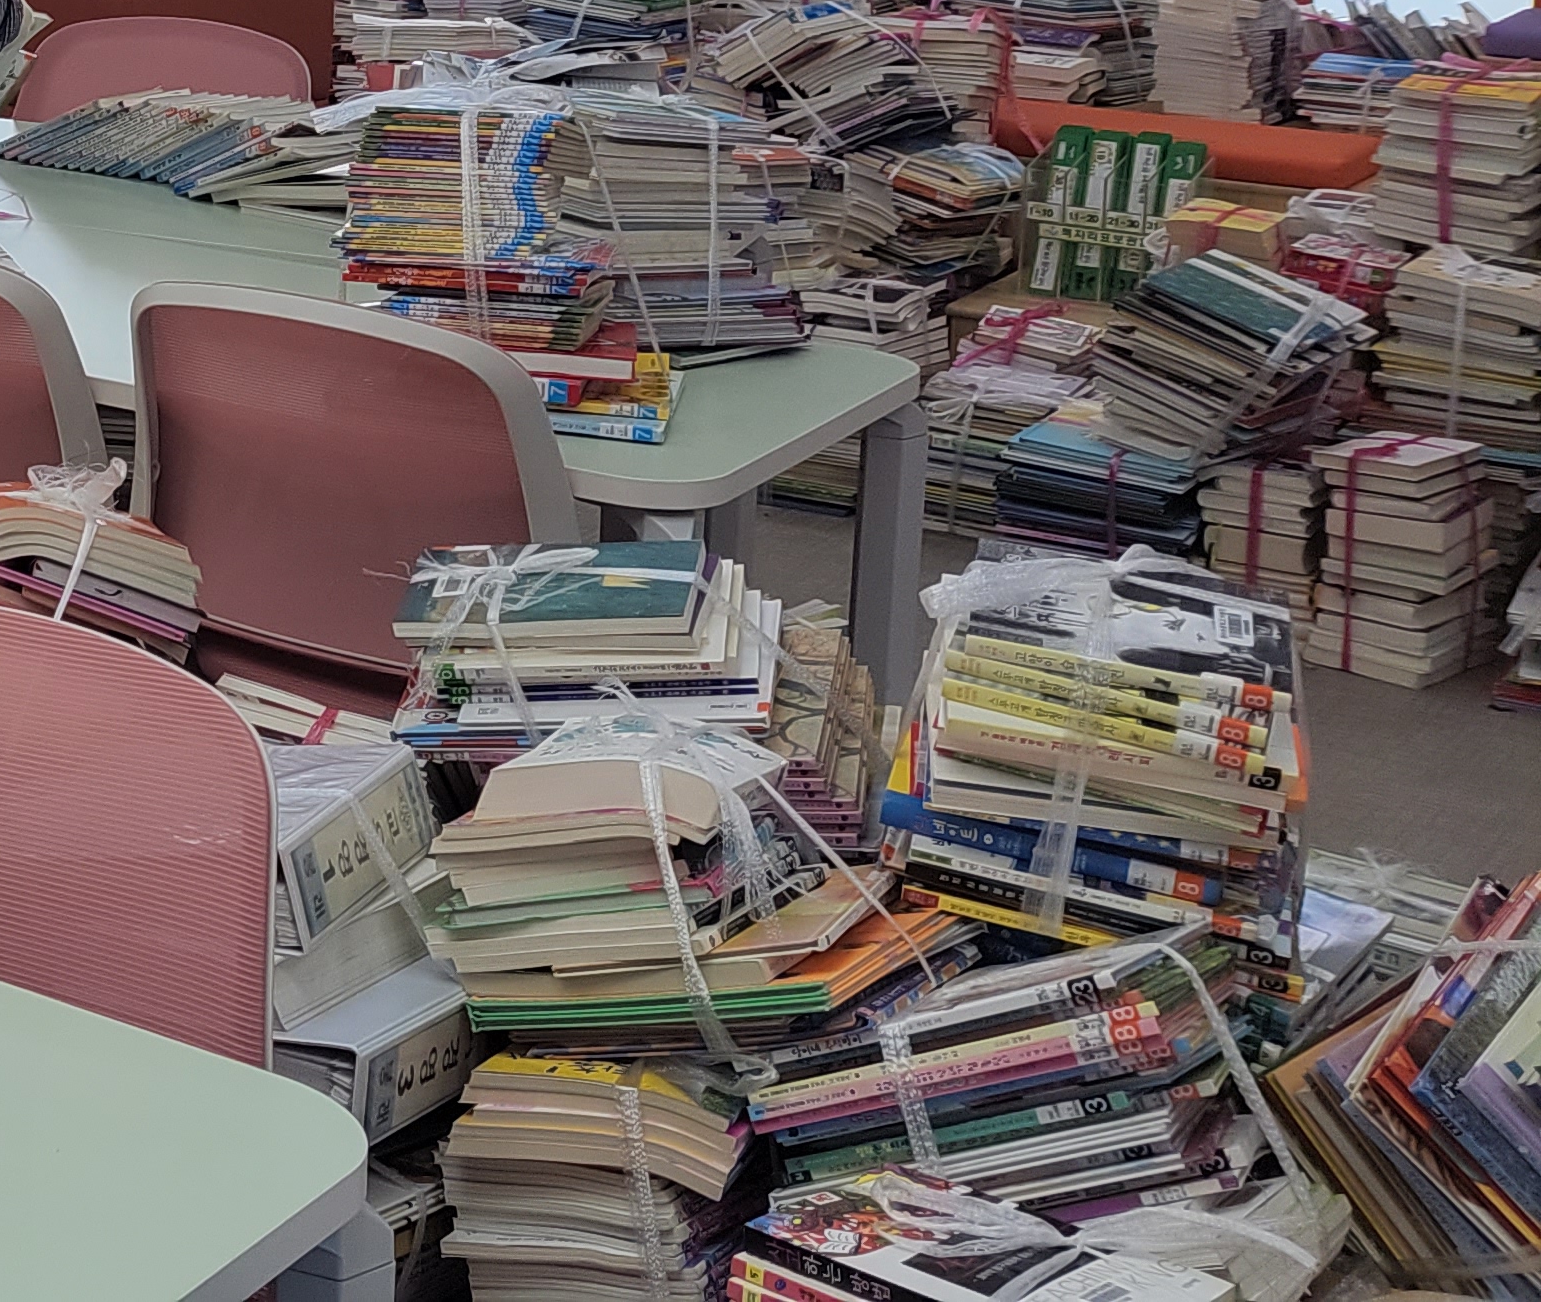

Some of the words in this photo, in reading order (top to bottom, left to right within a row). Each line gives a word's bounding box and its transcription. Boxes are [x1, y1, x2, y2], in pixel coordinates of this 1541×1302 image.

[1244, 694, 1268, 708] 8
[1221, 726, 1245, 740] 8
[1218, 753, 1242, 767] 8
[1252, 775, 1276, 788] 3
[1177, 882, 1200, 895] 8
[1249, 949, 1274, 965] 3
[1112, 1007, 1135, 1021] 8
[1114, 1025, 1138, 1040] 8
[1084, 1097, 1108, 1113] 3
